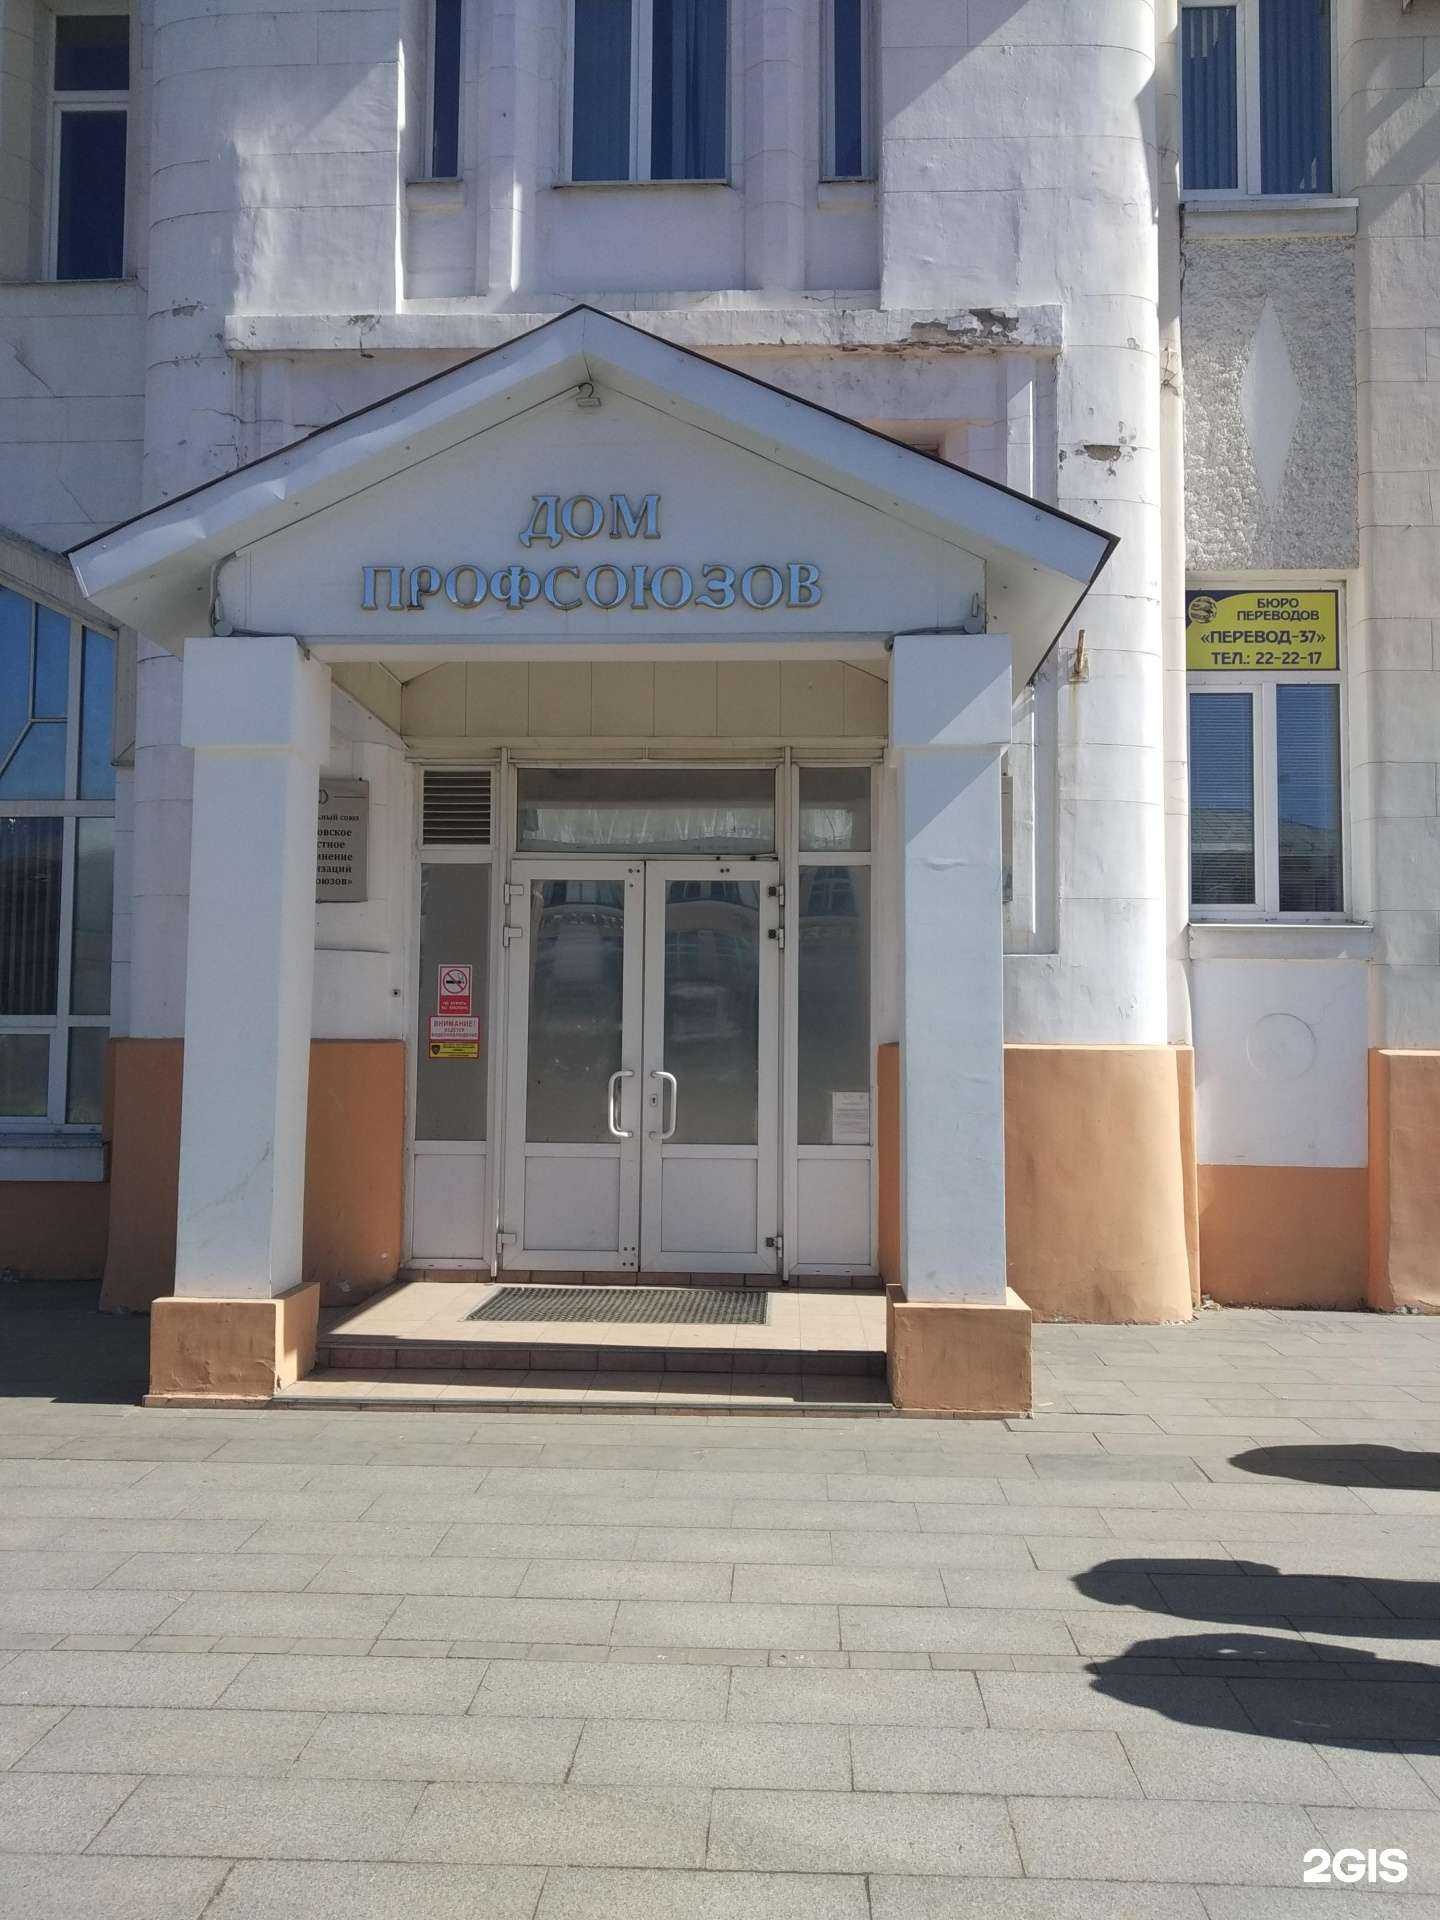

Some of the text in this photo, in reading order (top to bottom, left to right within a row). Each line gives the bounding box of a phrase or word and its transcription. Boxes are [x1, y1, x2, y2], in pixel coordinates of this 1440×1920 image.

[518, 494, 661, 549] ДОМ
[360, 562, 823, 611] ПРОФСОЮЗОВ
[1257, 598, 1299, 609] БЮРО
[1237, 610, 1320, 622] ПЕРЕВОДОВ
[1200, 630, 1327, 645] «ПЕРЕВОД-37»
[1211, 652, 1322, 665] ТЕЛ.: 22-22-17
